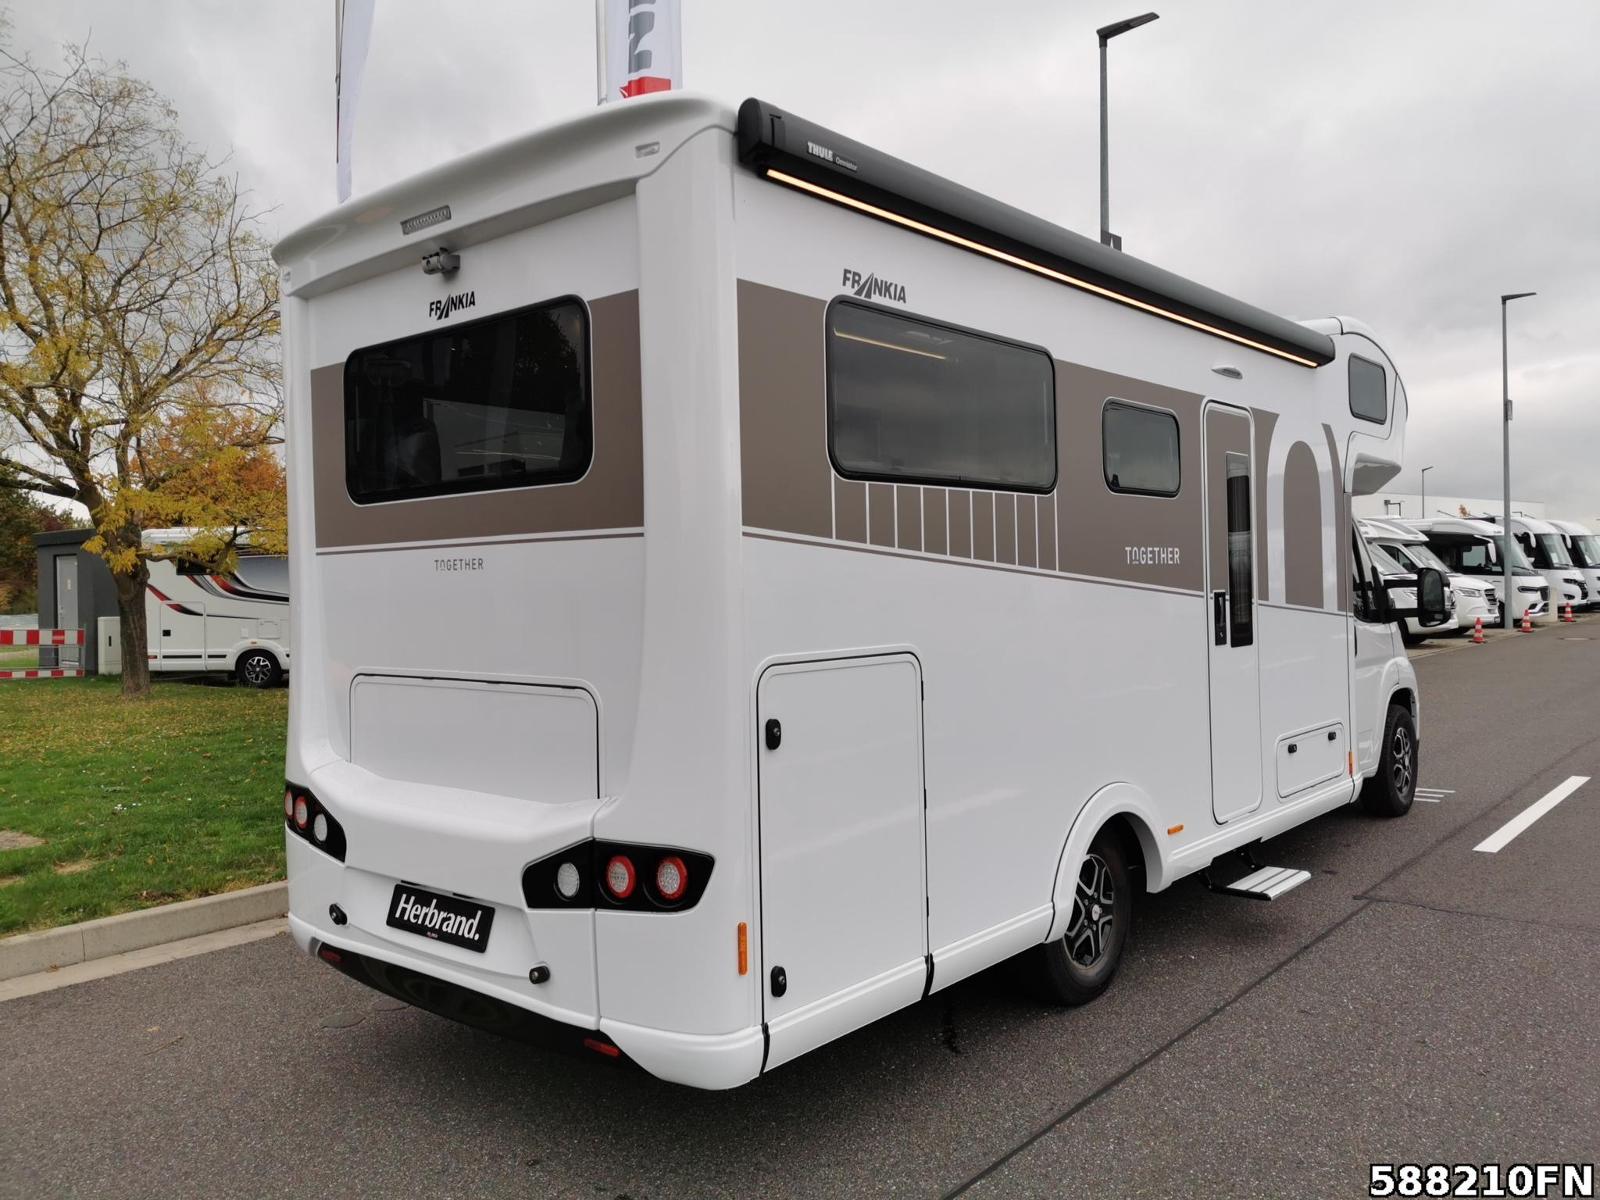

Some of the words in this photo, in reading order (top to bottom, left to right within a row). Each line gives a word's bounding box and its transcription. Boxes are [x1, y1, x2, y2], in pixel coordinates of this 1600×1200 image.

[807, 141, 834, 162] THULE
[842, 268, 907, 304] FRANKIA
[429, 291, 476, 320] FRANKIA
[434, 558, 484, 572] TOGETHER
[1125, 546, 1180, 565] TOGETHER
[395, 893, 482, 941] Herbrand.
